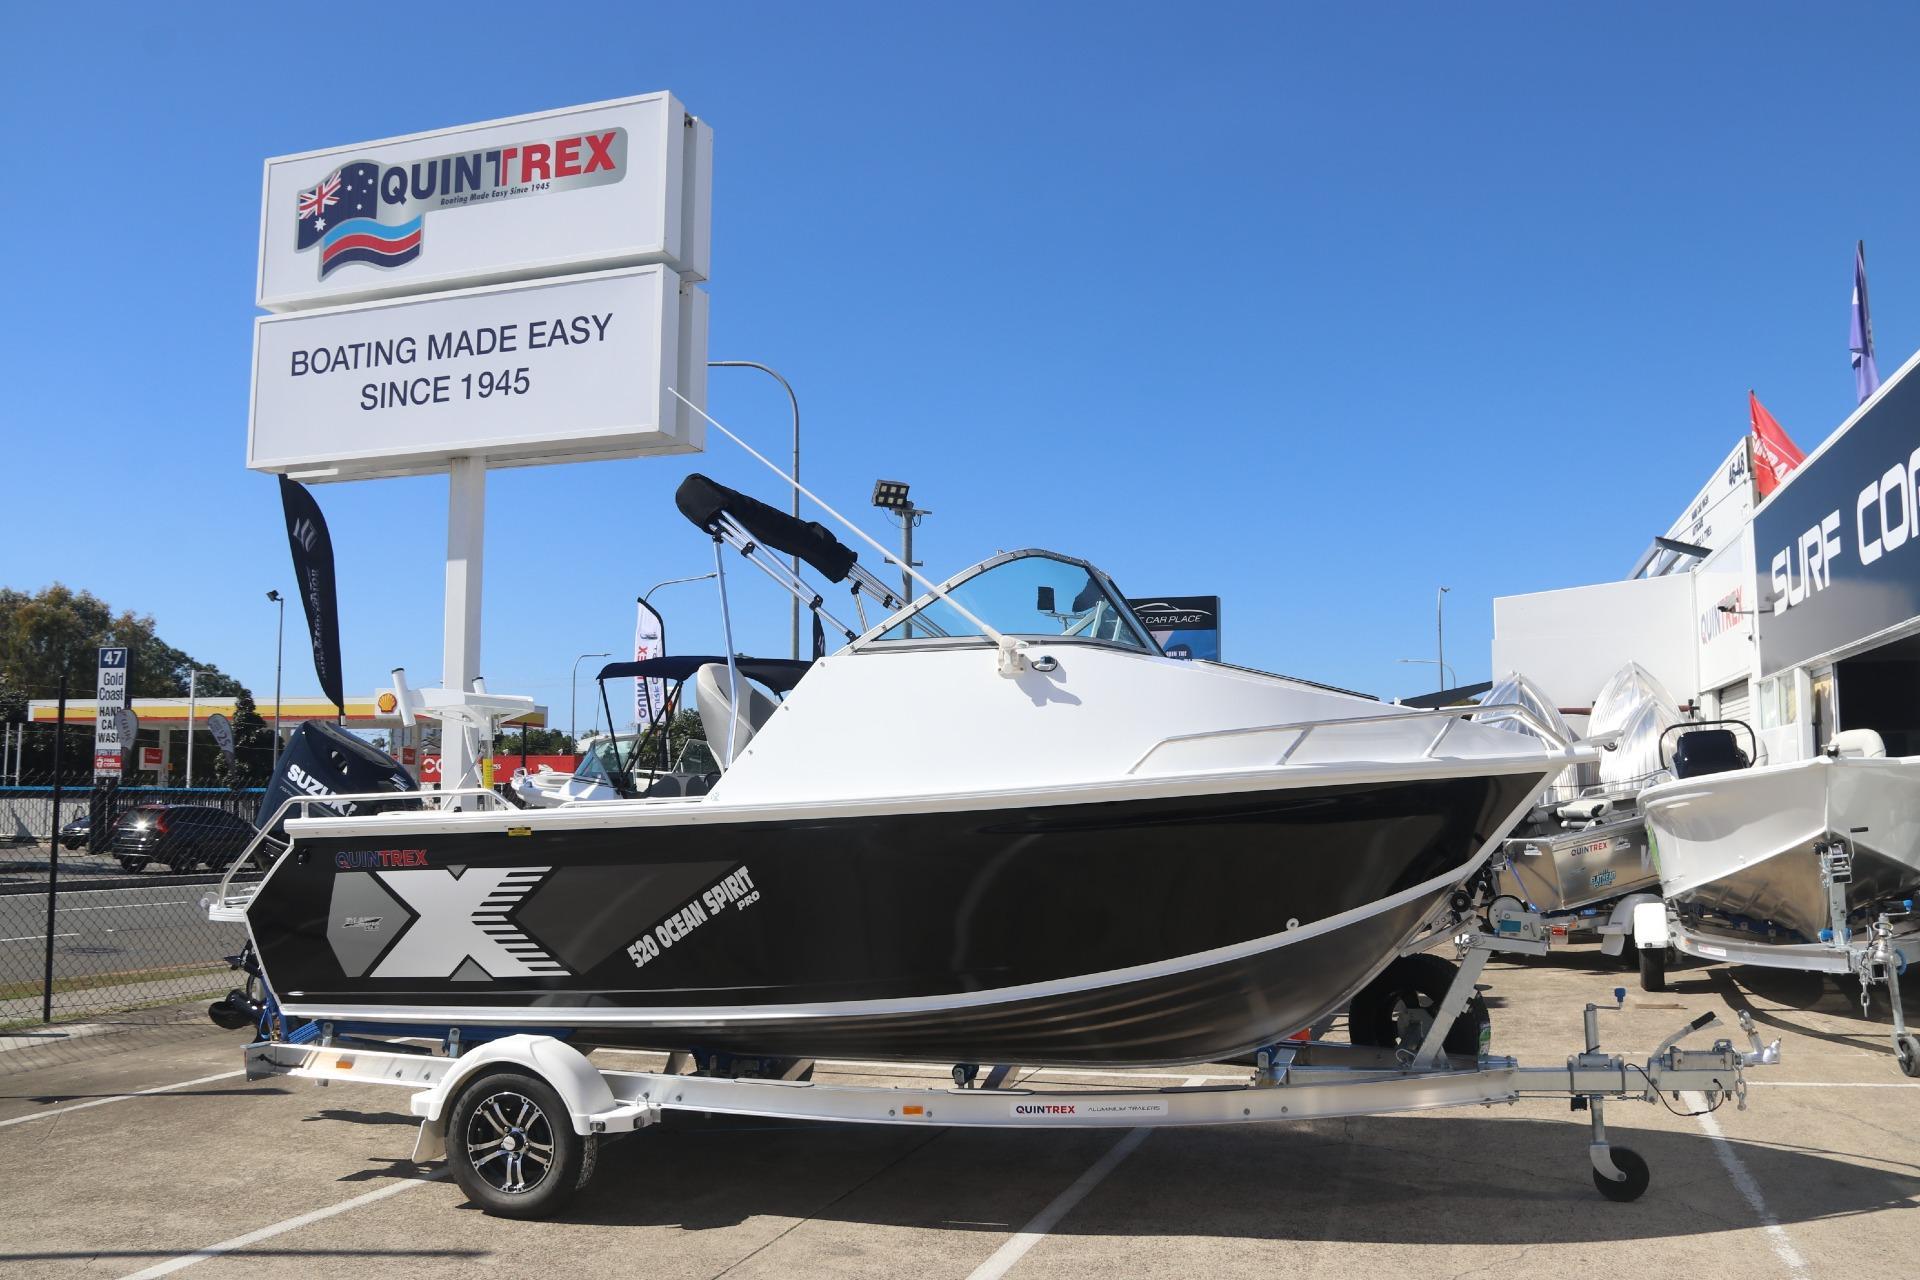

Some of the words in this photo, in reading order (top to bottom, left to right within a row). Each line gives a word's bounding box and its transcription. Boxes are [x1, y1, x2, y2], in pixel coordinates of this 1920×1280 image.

[381, 131, 617, 205] QUINTREX
[441, 195, 468, 205] Boating
[470, 191, 490, 201] Made
[492, 188, 508, 199] Easy
[510, 186, 528, 195] Since
[531, 181, 550, 191] 1945
[291, 336, 417, 377] BOATING
[427, 325, 518, 360] MADE
[528, 313, 613, 349] EASY
[360, 375, 450, 411] SINCE
[461, 367, 530, 400] 1945
[1771, 509, 1841, 617] SURF
[1146, 616, 1167, 624] CAR
[1168, 614, 1202, 623] PLACE
[104, 651, 122, 665] 47
[103, 672, 124, 686] Gold
[99, 687, 124, 701] Coast
[1571, 841, 1608, 856] QUINTREX
[336, 849, 429, 869] QUINTREX
[736, 890, 761, 911] PRO
[626, 934, 660, 968] 520
[655, 899, 708, 949] OCEAN
[702, 865, 755, 916] SPIRIT
[1016, 1105, 1076, 1115] QUINTREX
